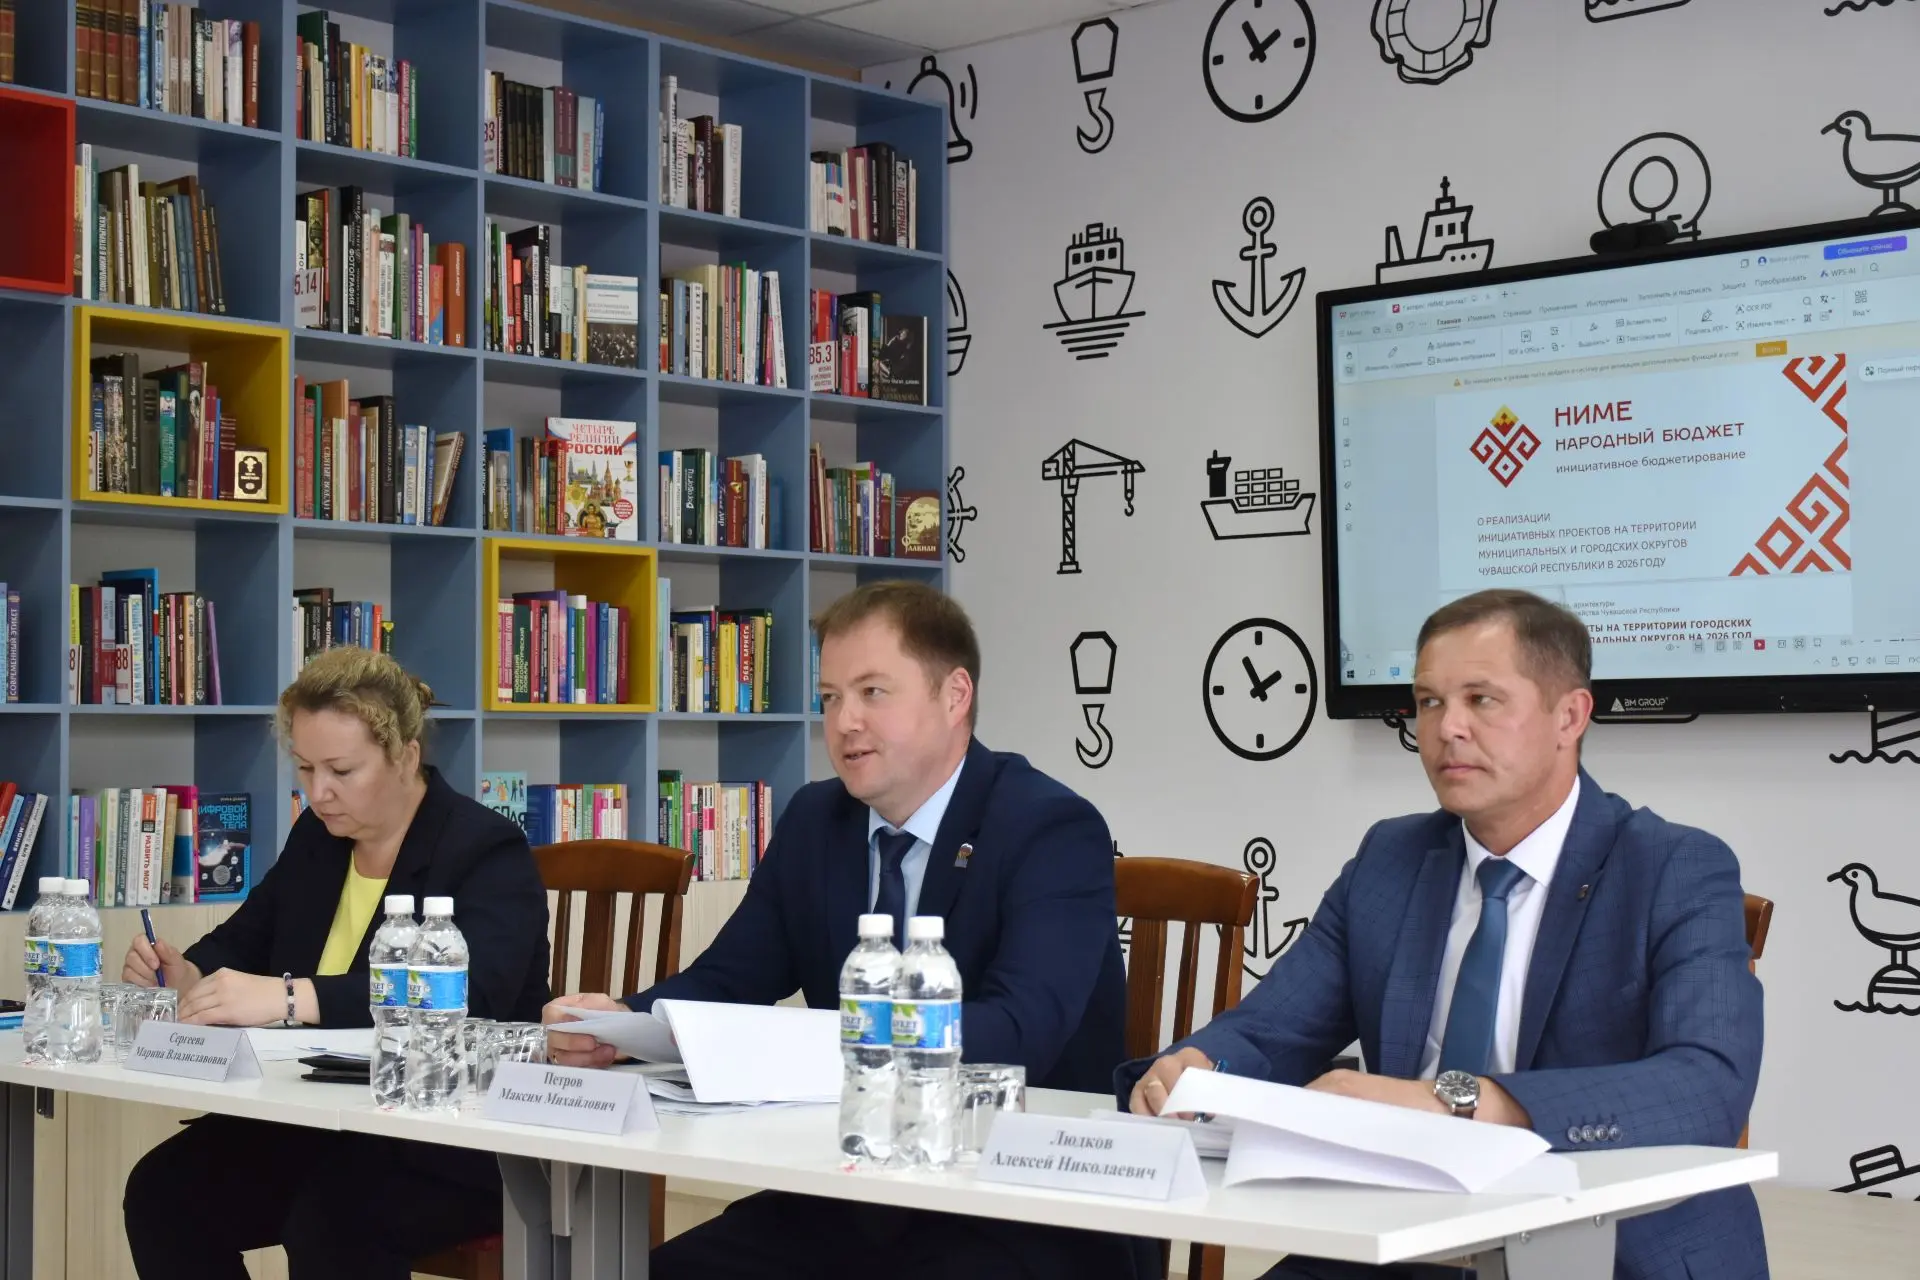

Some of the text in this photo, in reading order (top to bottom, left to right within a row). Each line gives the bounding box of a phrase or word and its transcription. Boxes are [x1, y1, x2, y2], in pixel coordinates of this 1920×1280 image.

[99, 256, 107, 292] СОКОЛЬНИКИ
[1436, 318, 1462, 326] Главная
[1554, 400, 1632, 428] НИМЕ
[572, 424, 615, 434] ЧЕТЫРЕ
[1555, 422, 1746, 452] НАРОДНЫЙ БЮДЖЕТ
[570, 433, 620, 444] РЕЛИГИИ
[566, 442, 622, 456] РОССИИ
[1556, 449, 1746, 474] инициативное бюджетирование
[1477, 512, 1551, 526] О РЕАЛИЗАЦИИ
[1478, 520, 1697, 544] ИНИЦИАТИВНЫХ ПРОЕКТОВ НА ТЕРРИТОРИИ
[1478, 538, 1688, 560] МУНИЦИПАЛЬНЫХ И ГОРОДСКИХ ОКРУГОВ
[1478, 556, 1666, 576] ЧУВАШСКОЙ РЕСПУБЛИКИ В 2026 ГОДУ
[1639, 606, 1680, 616] Республики
[1606, 624, 1620, 632] НА
[1623, 621, 1687, 632] ТЕРРИТОРИИ
[1690, 618, 1752, 629] ГОРОДСКИХ
[1706, 632, 1728, 640] 2026
[10, 608, 18, 696] СОВРЕМЕННЫЙ ЭТИКЕТ
[1638, 698, 1666, 706] GROUP
[220, 812, 248, 821] ЯЗЫК
[223, 820, 248, 828] ТЕЛА
[169, 1032, 205, 1046] Сергеева
[136, 1046, 228, 1066] Марина Владиславовна
[544, 1072, 583, 1088] Петров
[498, 1088, 616, 1112] Максим Михайлович
[1050, 1130, 1114, 1150] Людков
[990, 1151, 1157, 1180] Алексей Николаевич
